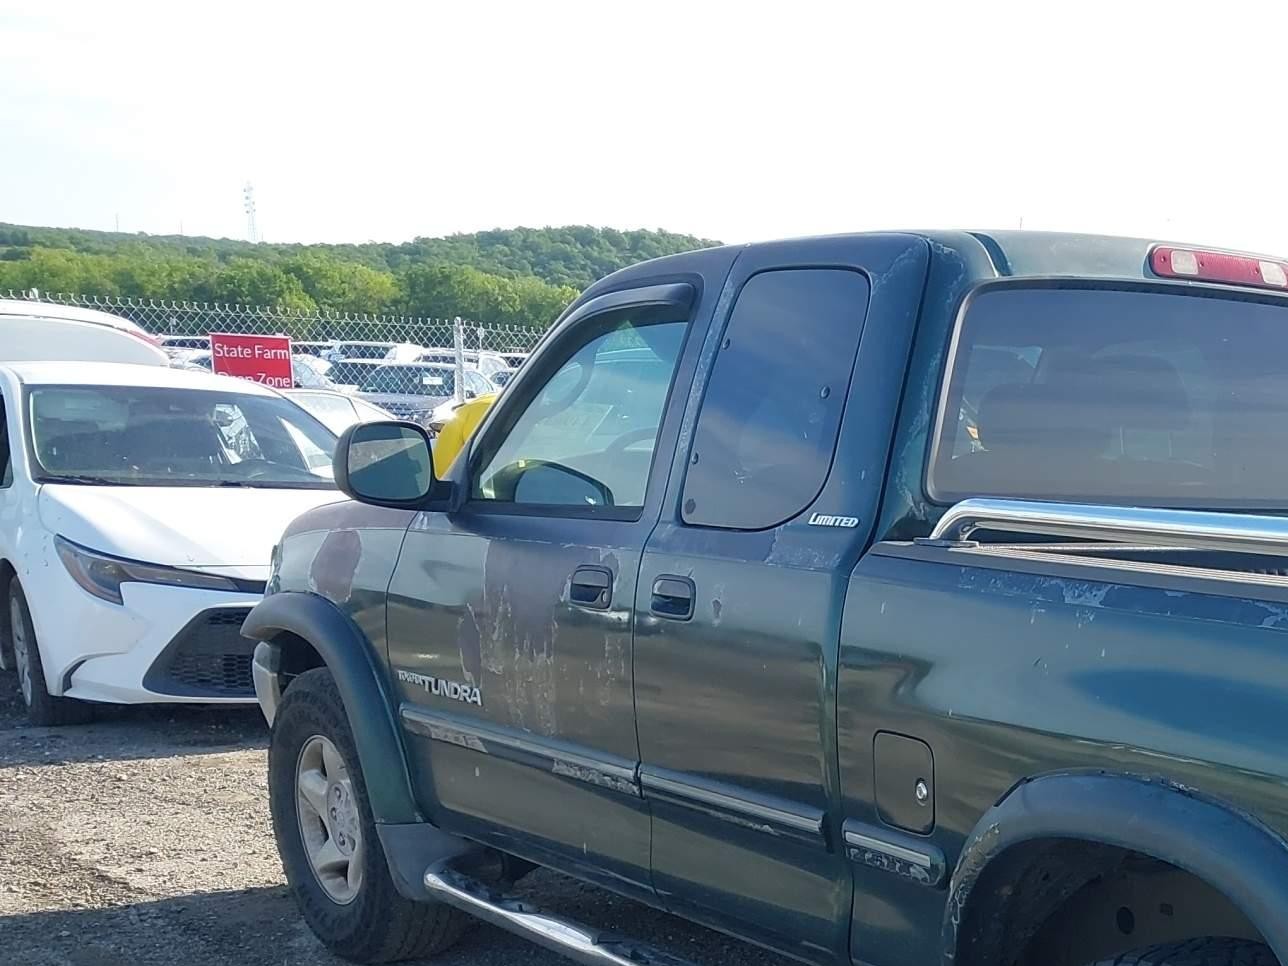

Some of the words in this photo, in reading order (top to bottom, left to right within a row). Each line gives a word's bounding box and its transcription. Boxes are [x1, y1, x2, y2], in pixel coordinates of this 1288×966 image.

[214, 343, 252, 358] State
[254, 344, 289, 360] Farm
[256, 372, 290, 387] Zone
[808, 512, 860, 528] LIMITED
[422, 675, 482, 706] TUNDRA
